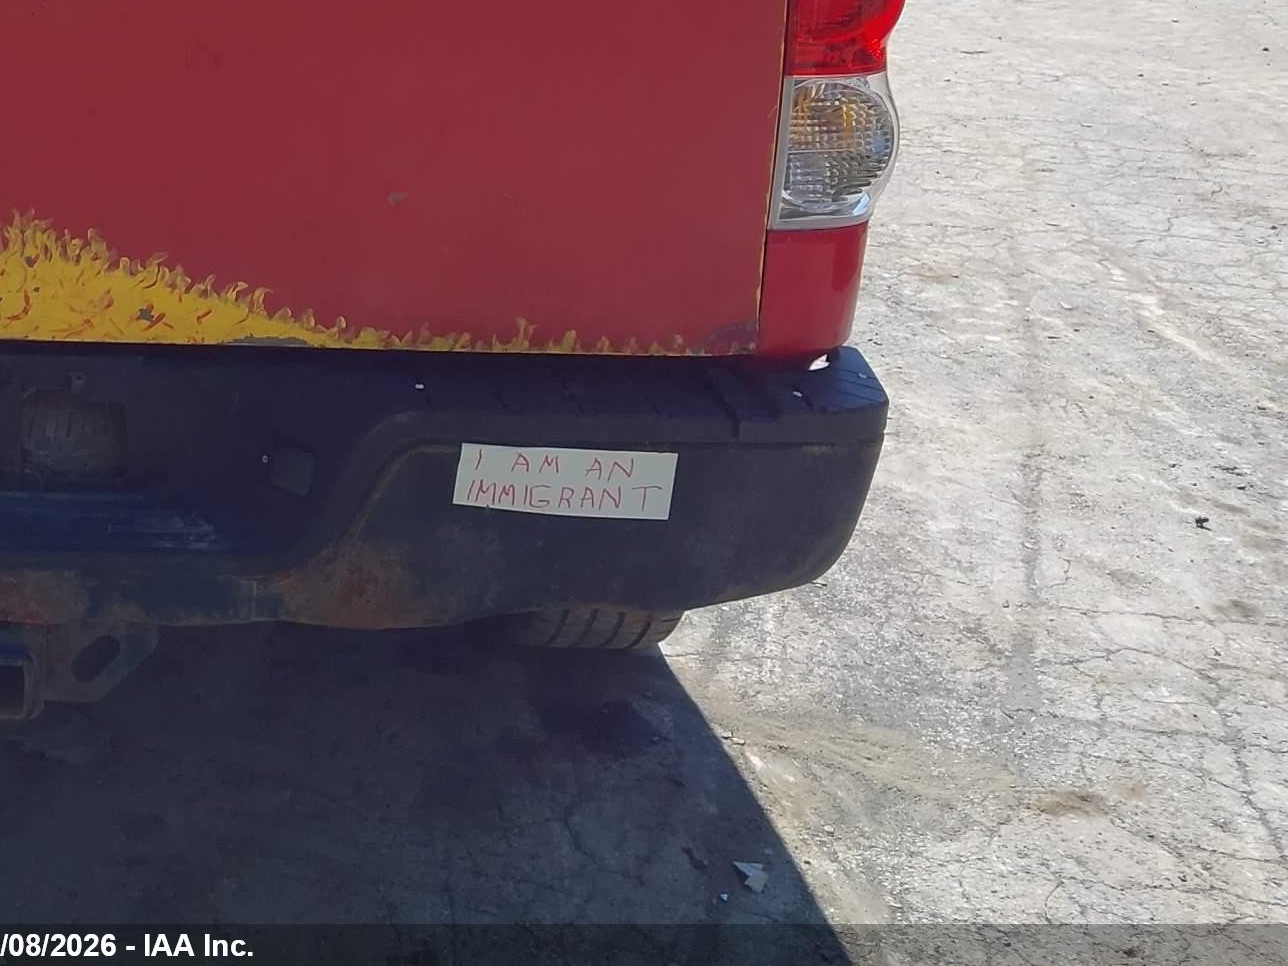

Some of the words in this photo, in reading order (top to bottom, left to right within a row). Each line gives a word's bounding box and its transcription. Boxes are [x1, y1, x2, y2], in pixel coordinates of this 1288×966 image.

[474, 449, 482, 470] I
[511, 452, 560, 473] AM
[585, 457, 634, 482] AN
[466, 479, 662, 511] IMMIGRANT
